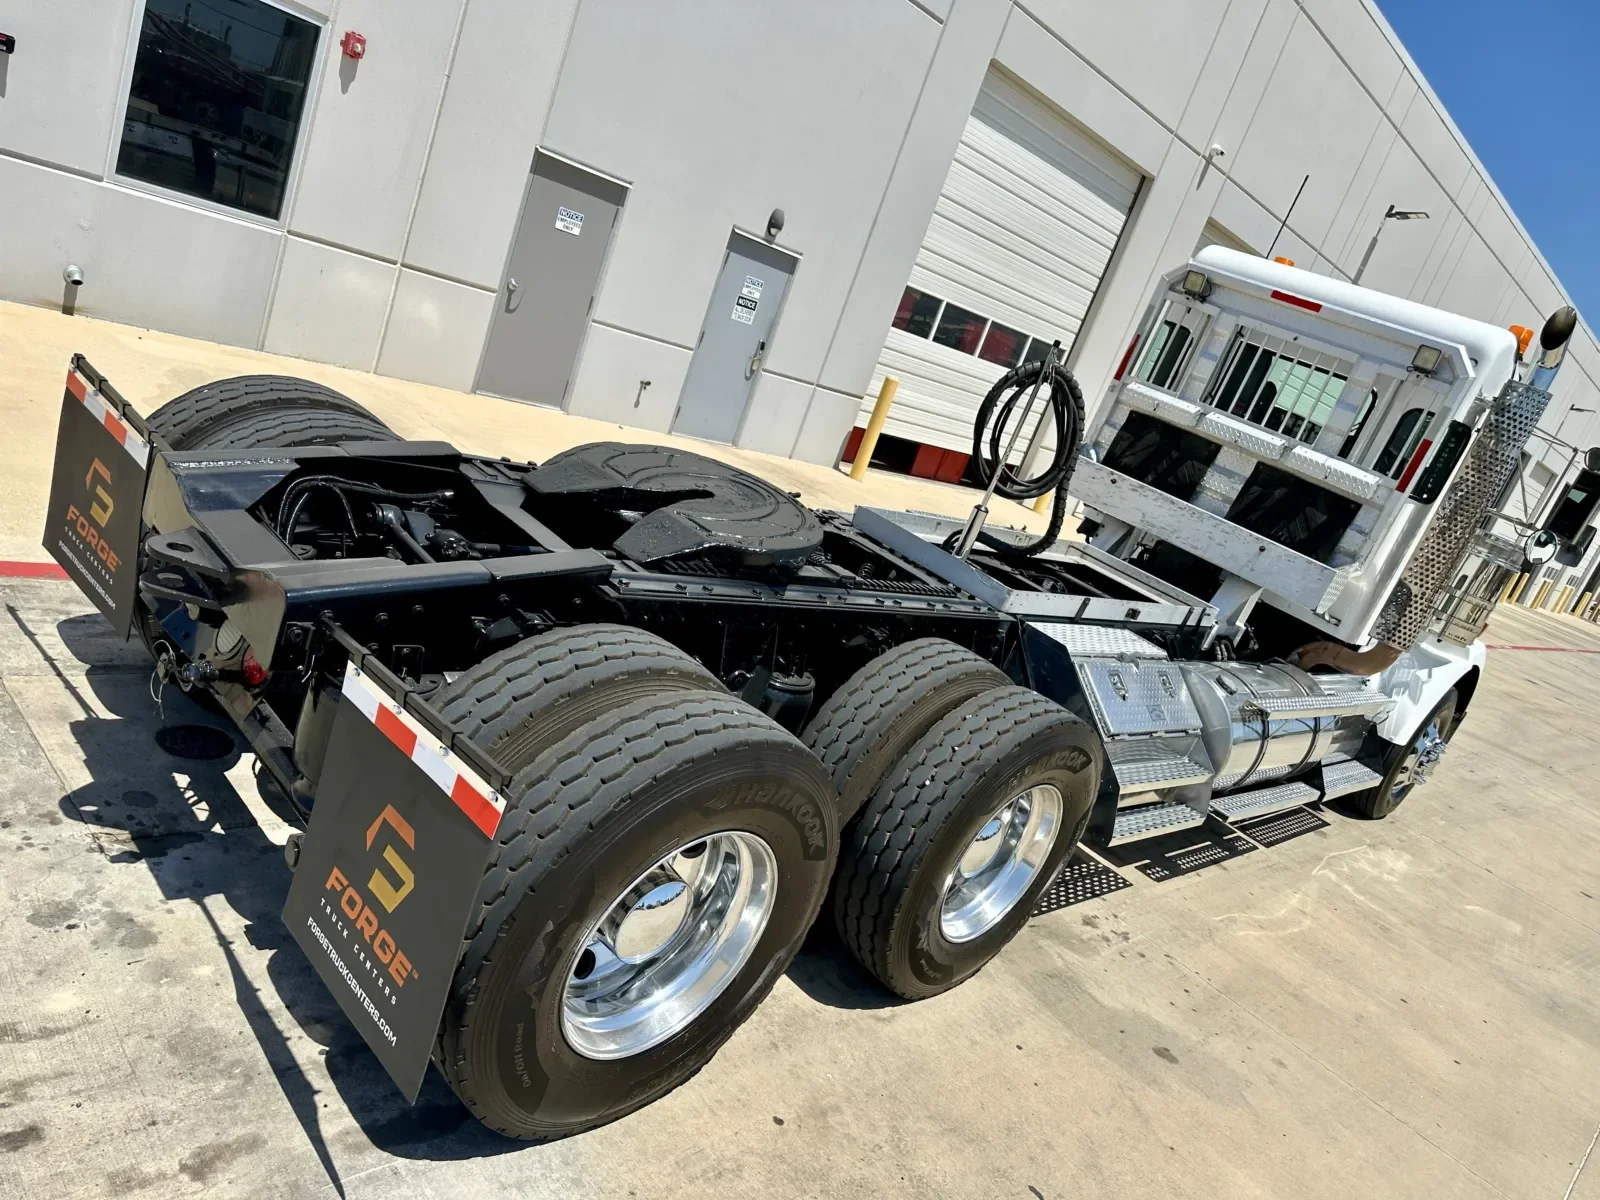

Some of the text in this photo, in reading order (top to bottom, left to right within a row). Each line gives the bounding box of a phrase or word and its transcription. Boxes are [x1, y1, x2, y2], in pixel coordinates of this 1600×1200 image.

[560, 209, 583, 222] NOTICE
[737, 298, 756, 309] NOTICE
[64, 526, 114, 585] TRUCK CENTERS
[66, 504, 120, 573] FORGE
[320, 897, 397, 1005] TRUCK CENTERS
[324, 866, 413, 988] FORGE
[307, 916, 397, 1047] FORGETRUCKCENTERS.COM
